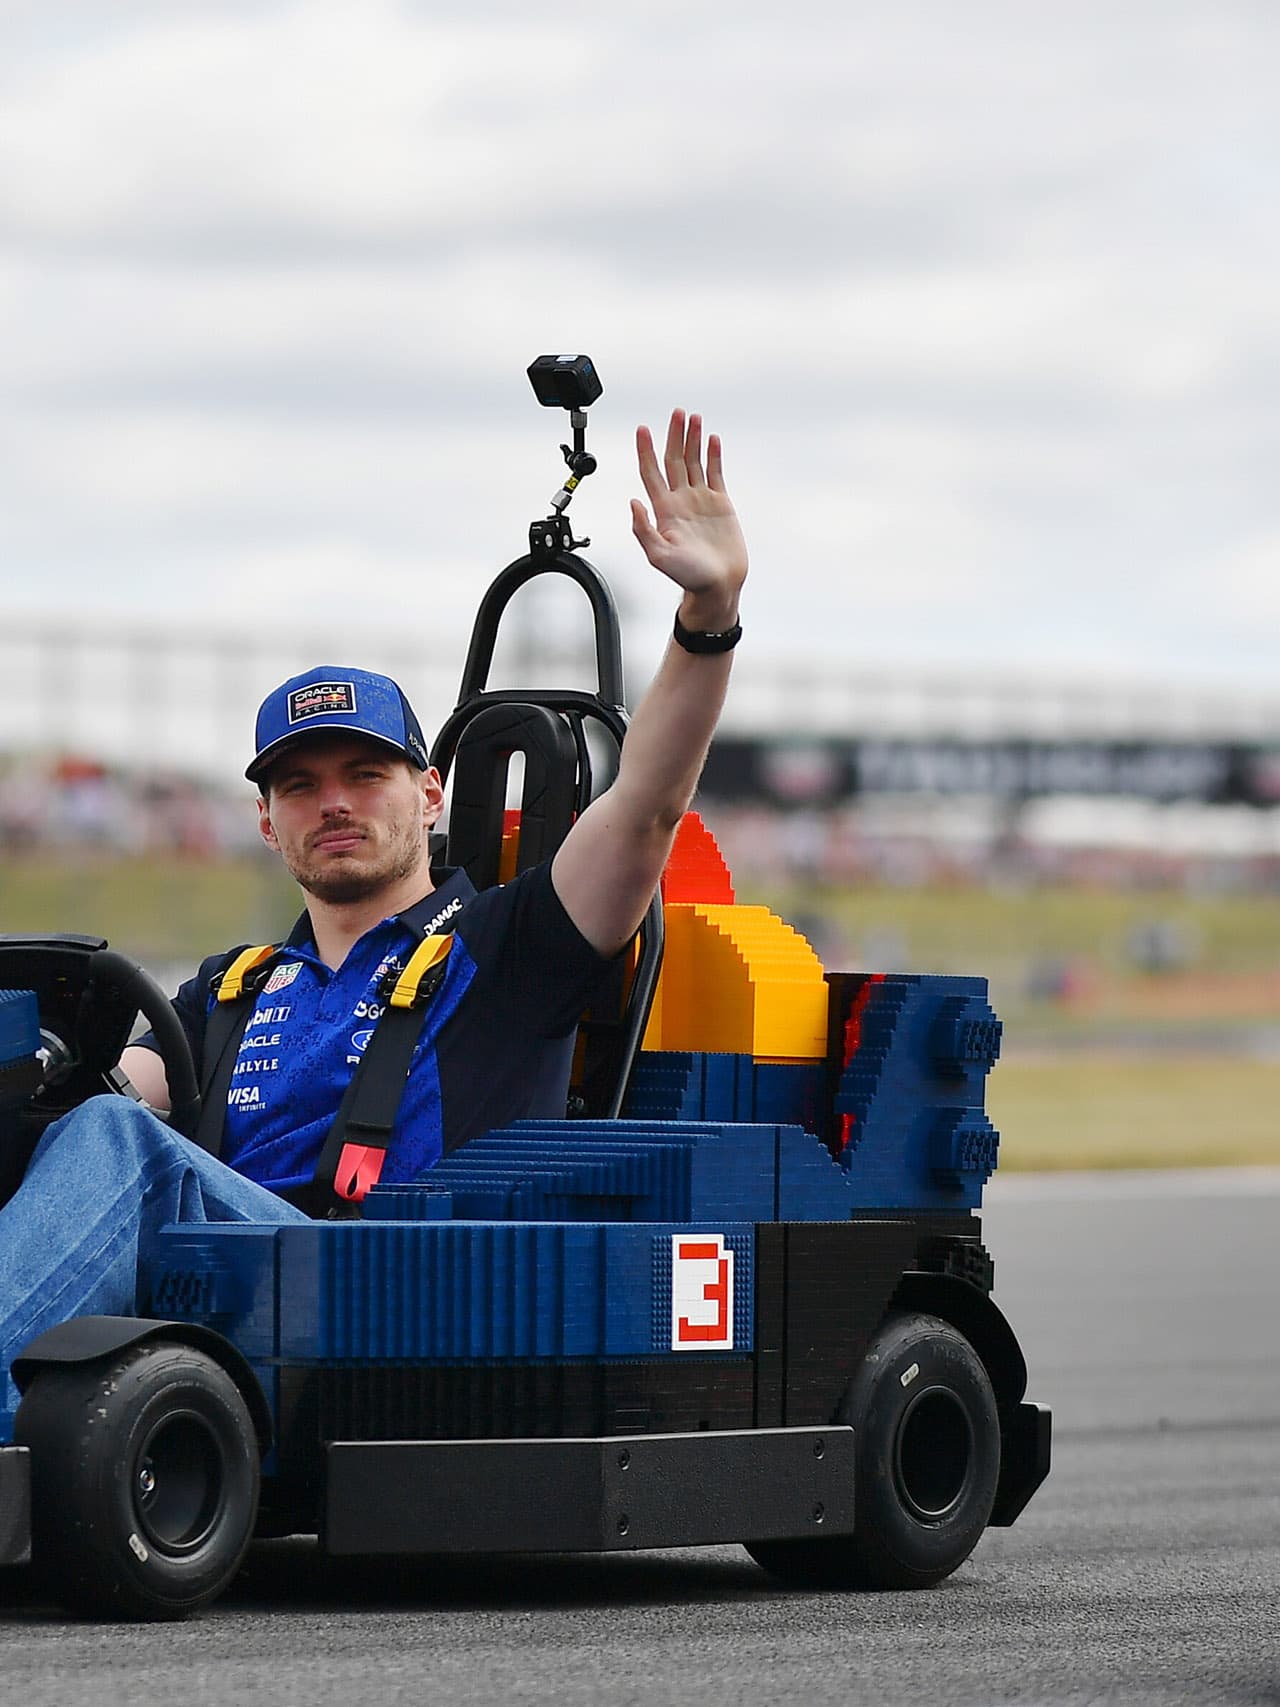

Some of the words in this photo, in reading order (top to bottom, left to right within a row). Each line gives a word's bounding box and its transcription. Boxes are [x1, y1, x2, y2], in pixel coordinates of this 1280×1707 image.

[295, 686, 346, 702] ORACLE
[423, 897, 463, 936] DAMAC
[227, 1086, 260, 1105] VISA
[677, 1241, 730, 1343] 3
